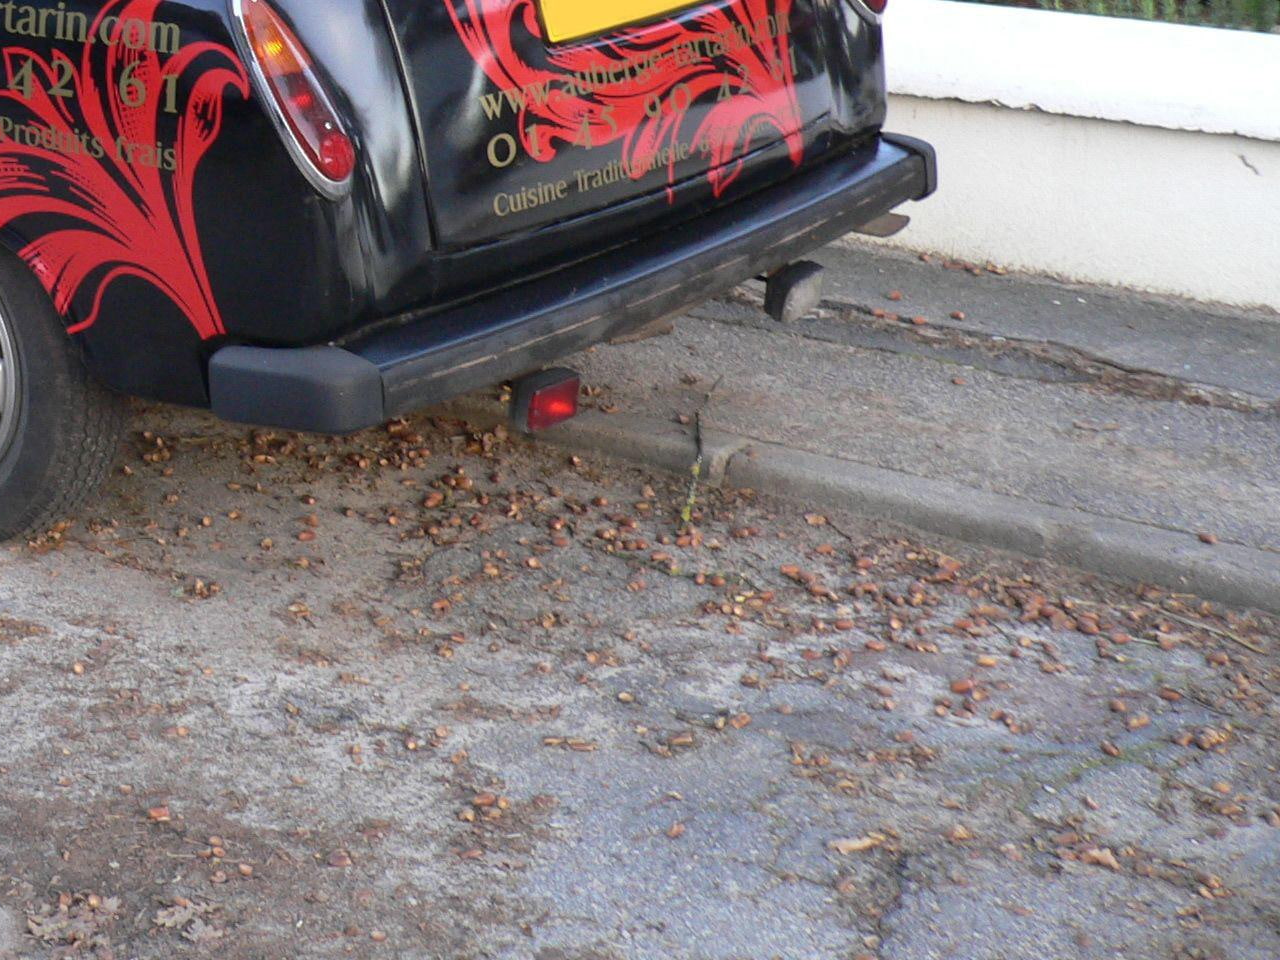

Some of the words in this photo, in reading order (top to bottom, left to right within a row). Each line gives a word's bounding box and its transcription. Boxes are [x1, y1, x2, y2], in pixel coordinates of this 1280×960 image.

[8, 56, 75, 100] 42
[118, 59, 180, 114] 61
[115, 136, 177, 172] frais
[486, 122, 543, 169] 01
[493, 179, 568, 217] Cuisine
